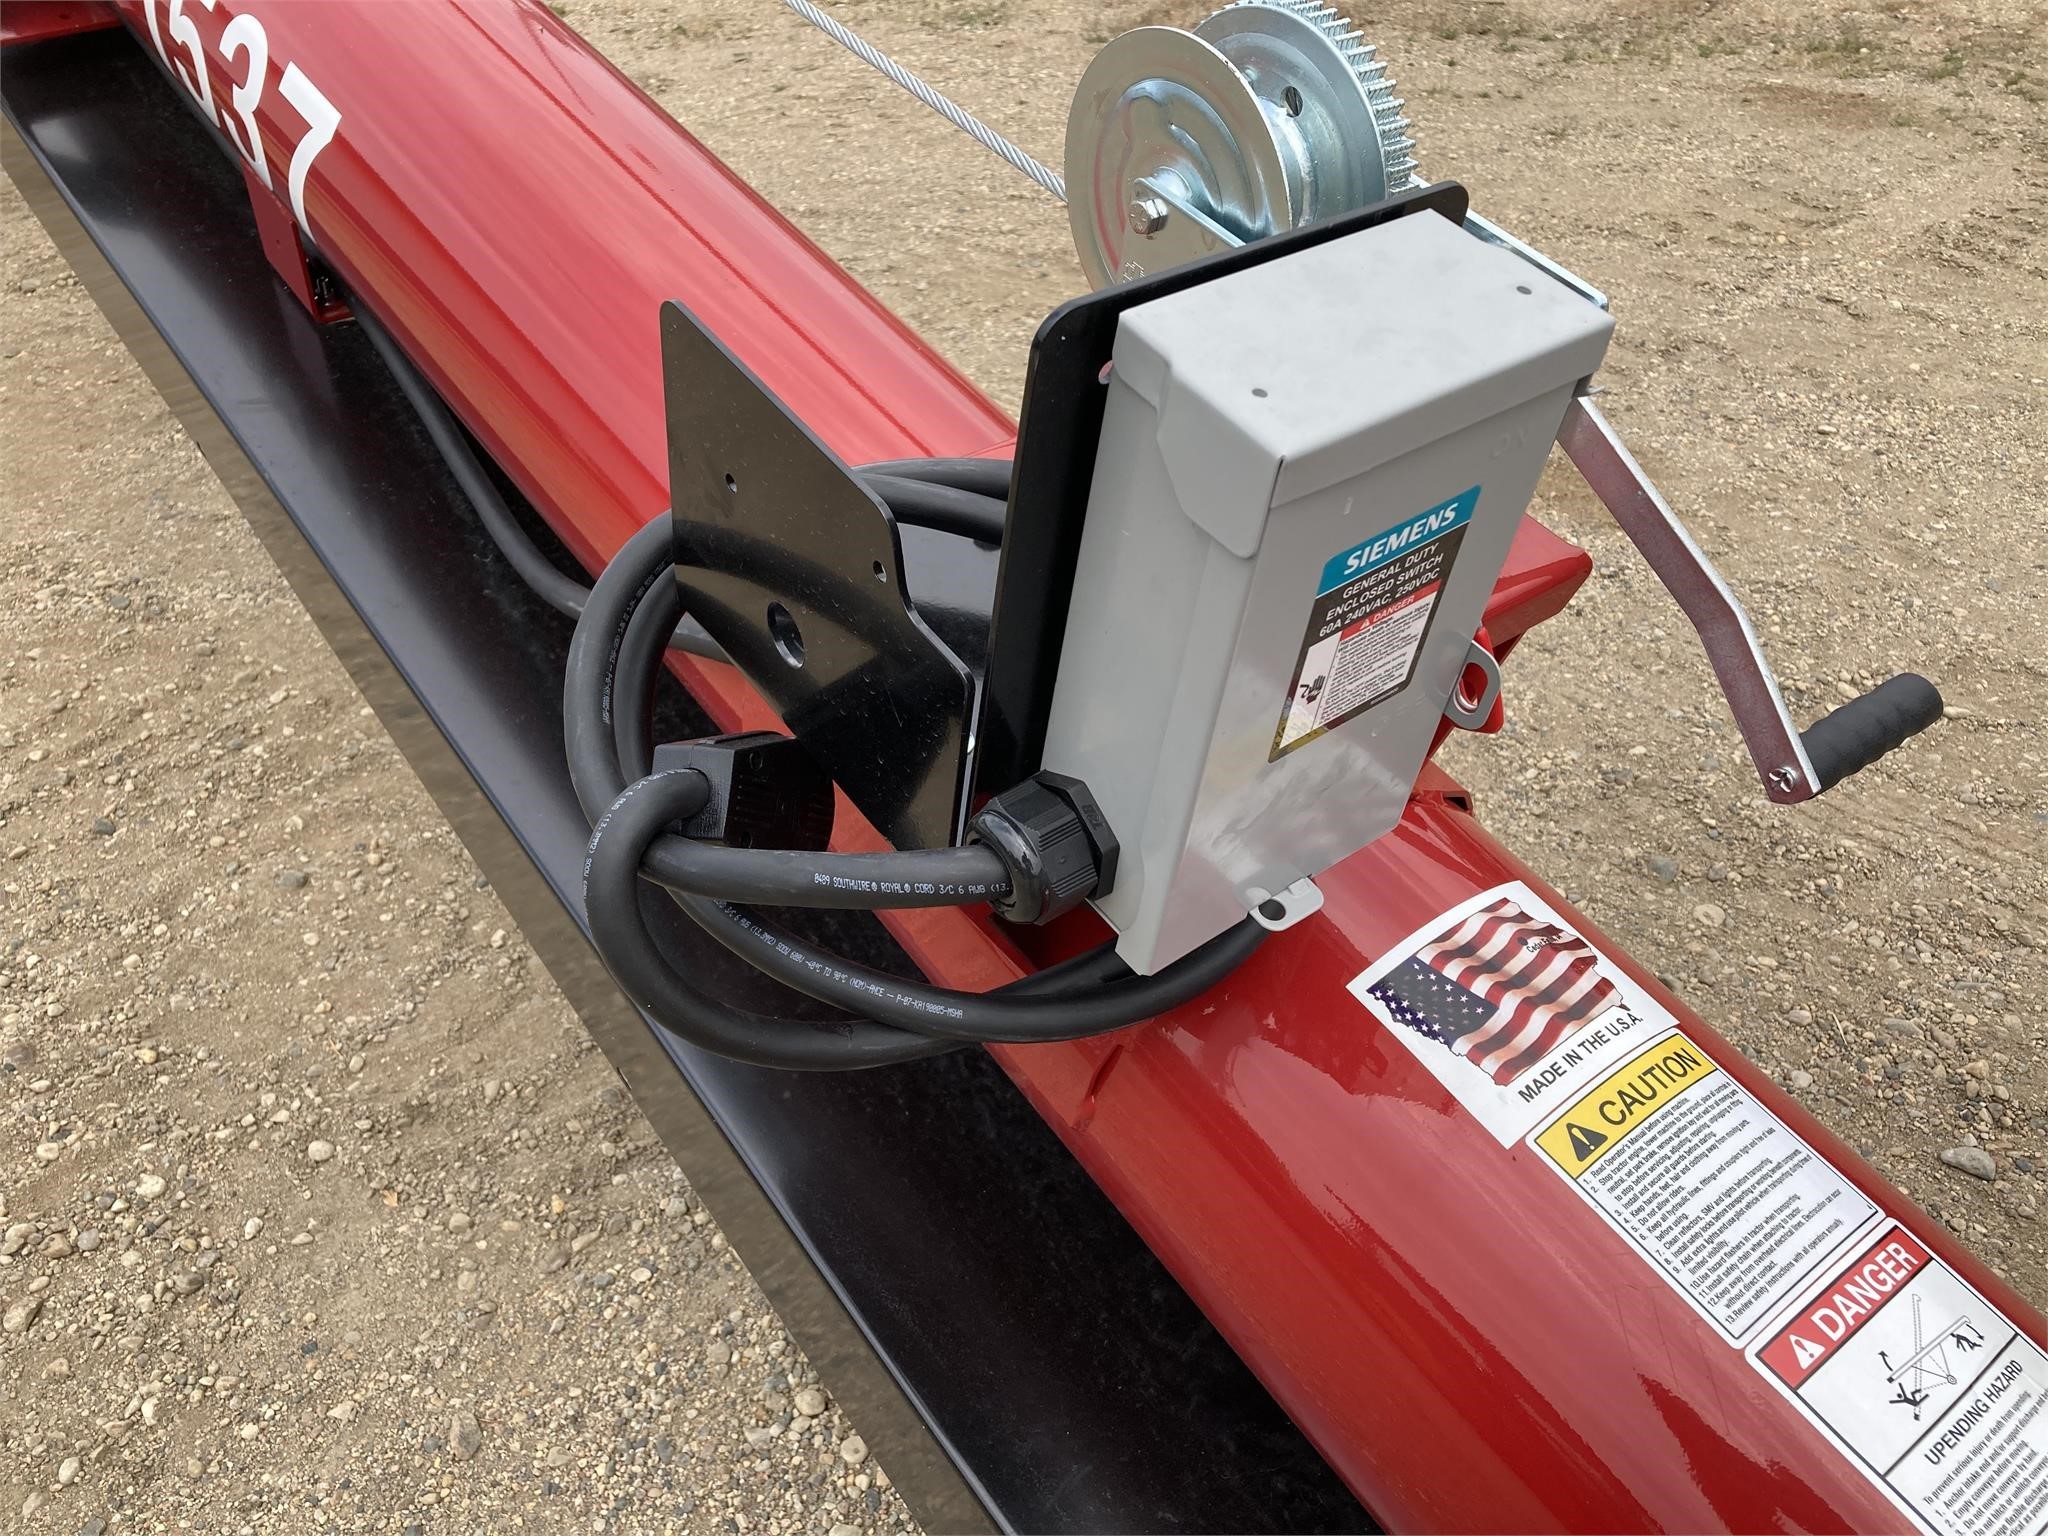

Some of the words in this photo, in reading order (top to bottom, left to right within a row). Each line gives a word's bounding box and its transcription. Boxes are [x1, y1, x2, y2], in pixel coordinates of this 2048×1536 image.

[1343, 563, 1400, 598] GENERAL
[1404, 542, 1438, 567] DUTY
[1345, 504, 1456, 573] SIEMENS
[1319, 619, 1341, 636] 60A
[1395, 568, 1439, 597] 250VDC
[1326, 579, 1394, 620] ENCLOSED
[1396, 553, 1443, 584] SWITCH
[1373, 595, 1414, 622] DANGER
[914, 884, 935, 895] CORD
[939, 884, 954, 895] 3/C
[958, 885, 964, 894] 6
[1518, 1062, 1567, 1102] MADE
[1561, 1049, 1583, 1067] IN
[1577, 1030, 1610, 1054] THE
[1605, 1010, 1643, 1036] U.S.A.
[1599, 1048, 1700, 1125] CAUTION
[1590, 1163, 1607, 1178] Read
[1627, 1128, 1647, 1146] Manual
[1643, 1118, 1661, 1132] before
[1658, 1109, 1674, 1121] using
[1598, 1173, 1613, 1186] Stop
[1610, 1158, 1629, 1175] tractor
[1642, 1133, 1659, 1147] lower
[1656, 1119, 1677, 1136] machine
[1632, 1159, 1645, 1173] park
[1656, 1135, 1675, 1151] remove
[1670, 1123, 1689, 1138] ignition
[1620, 1184, 1634, 1197] stop
[1630, 1170, 1650, 1186] before
[1621, 1192, 1640, 1210] Install
[1647, 1171, 1665, 1188] secure
[1669, 1153, 1687, 1170] guards
[1683, 1142, 1701, 1156] before
[1629, 1204, 1645, 1218] Keep
[1668, 1172, 1682, 1183] hair
[1688, 1151, 1709, 1167] clothing
[1705, 1142, 1719, 1154] away
[1714, 1135, 1728, 1145] from
[1645, 1220, 1662, 1234] Keep
[1665, 1195, 1690, 1216] hydraulic
[1699, 1171, 1718, 1187] fittings
[1723, 1151, 1743, 1168] couplers
[1655, 1196, 1670, 1211] allow
[1654, 1224, 1674, 1242] before
[1662, 1234, 1680, 1250] Clean
[1721, 1185, 1737, 1199] lights
[1732, 1174, 1750, 1189] before
[1670, 1241, 1689, 1259] Install
[1686, 1230, 1704, 1245] safety
[1698, 1219, 1715, 1233] locks
[1710, 1207, 1729, 1222] before
[1725, 1187, 1754, 1210] transporting
[1754, 1171, 1773, 1186] working
[1691, 1243, 1707, 1257] extra
[1703, 1231, 1720, 1245] lights
[1733, 1207, 1747, 1221] pilot
[1743, 1196, 1760, 1211] vehicle
[1757, 1187, 1771, 1199] when
[1706, 1255, 1727, 1274] hazard
[1723, 1240, 1745, 1259] flashers
[1747, 1222, 1765, 1238] tractor
[1762, 1212, 1777, 1225] when
[1687, 1255, 1709, 1275] limited
[1721, 1261, 1740, 1278] safety
[1736, 1250, 1752, 1264] chain
[1749, 1239, 1765, 1252] when
[1762, 1222, 1785, 1242] attaching
[1728, 1274, 1744, 1289] away
[1739, 1263, 1756, 1277] from
[1753, 1243, 1776, 1266] overhead
[1773, 1227, 1795, 1248] electrical
[1751, 1284, 1769, 1301] safety
[1765, 1261, 1795, 1287] instructions
[1791, 1251, 1805, 1263] with
[1723, 1288, 1746, 1309] without
[1742, 1275, 1760, 1292] direct
[1812, 1243, 1916, 1339] DANGER
[1924, 1399, 1989, 1464] UPENDING
[1983, 1360, 2022, 1403] HAZARD
[1931, 1473, 1955, 1499] prevent
[1951, 1454, 1973, 1477] serious
[1968, 1439, 1988, 1457] injury
[1989, 1419, 2005, 1436] death
[2000, 1409, 2015, 1423] from
[1943, 1486, 1965, 1510] Anchor
[1961, 1470, 1981, 1489] intake
[2003, 1424, 2023, 1446] support
[1952, 1498, 1974, 1519] Empty
[1971, 1474, 1996, 1501] conveyor
[1992, 1457, 2012, 1477] before
[1981, 1492, 1999, 1510] move
[1996, 1468, 2020, 1495] conveyor
[1990, 1503, 2008, 1520] hitch
[2011, 1477, 2031, 1499] unhitch
[2004, 1503, 2027, 1526] flexible
